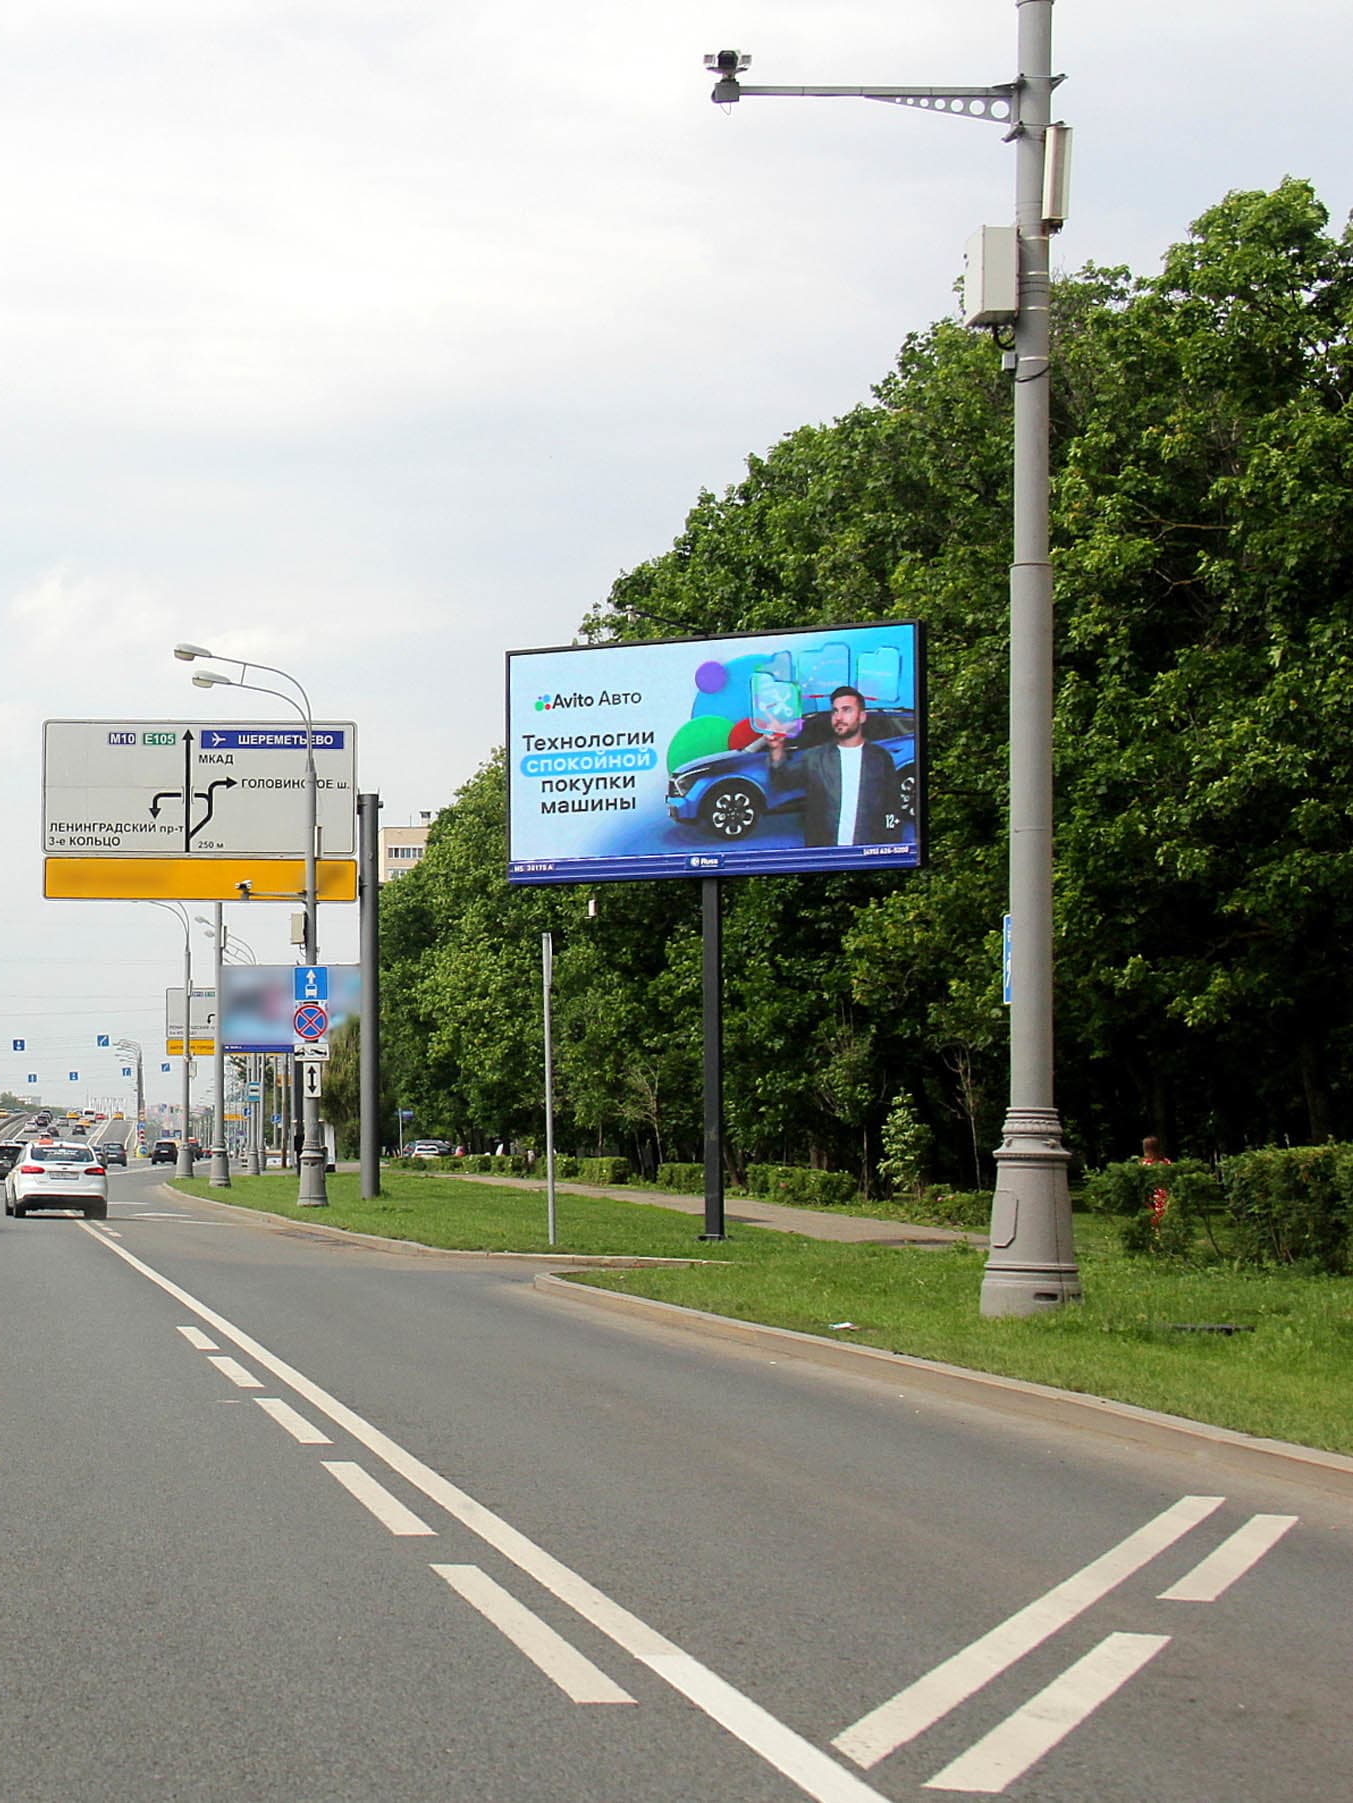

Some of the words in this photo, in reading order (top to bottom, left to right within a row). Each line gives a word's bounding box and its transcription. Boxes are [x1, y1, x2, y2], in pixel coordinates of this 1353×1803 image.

[552, 692, 594, 709] Avito
[598, 690, 642, 706] Авто
[522, 731, 654, 752] Технологии
[199, 754, 234, 765] МКАД
[526, 748, 651, 773] спокойной
[241, 778, 334, 789] ГОЛОВИНСОЕ
[541, 775, 636, 796] покупки
[541, 796, 636, 814] машины
[49, 821, 157, 833] ЛЕНИНГРАДСКИЙ
[159, 825, 184, 835] пр-т
[885, 813, 900, 829] 12+
[49, 837, 66, 846] 3-е
[69, 836, 121, 847] КОЛЬЦО
[197, 841, 214, 849] 250
